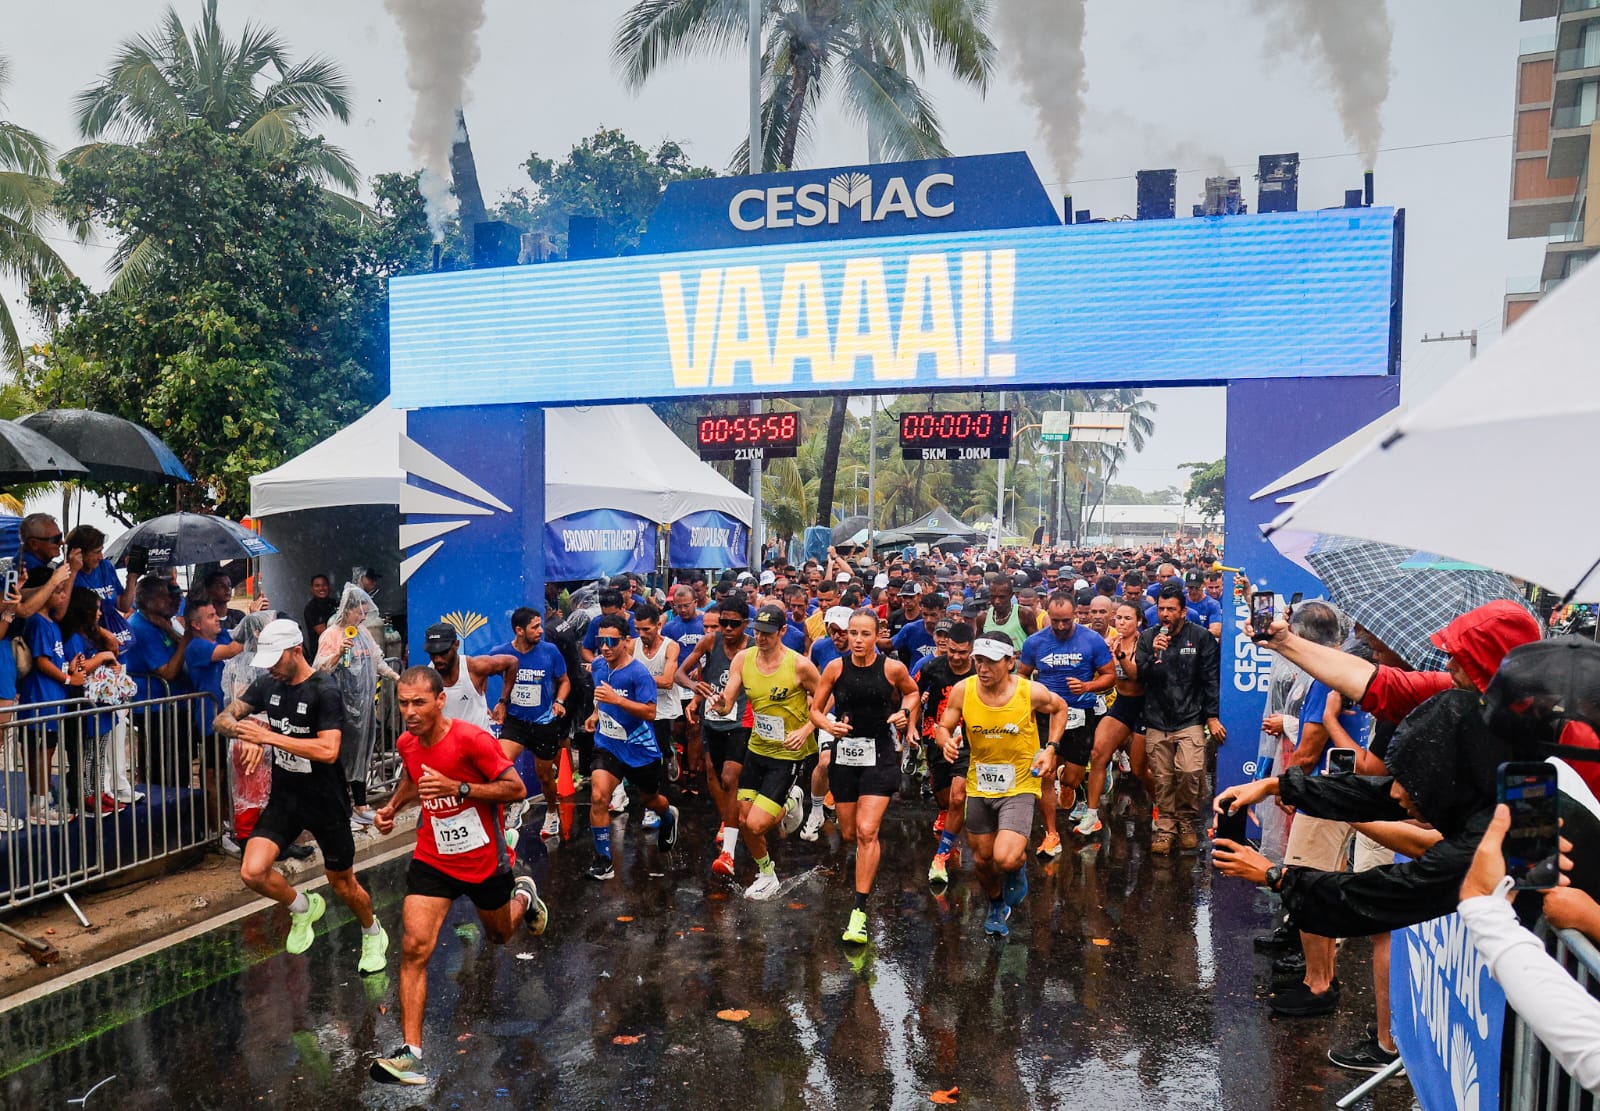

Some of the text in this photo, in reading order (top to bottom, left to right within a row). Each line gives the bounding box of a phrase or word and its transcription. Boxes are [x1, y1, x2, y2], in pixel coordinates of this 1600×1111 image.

[729, 172, 955, 233] CESMAC
[701, 415, 796, 443] 00:55:58
[903, 413, 1009, 438] 00:00:01
[735, 447, 764, 460] 21KM
[922, 447, 991, 460] 5KM 10KM
[842, 747, 865, 757] 1562
[981, 773, 1006, 783] 1874
[440, 826, 469, 842] 1733
